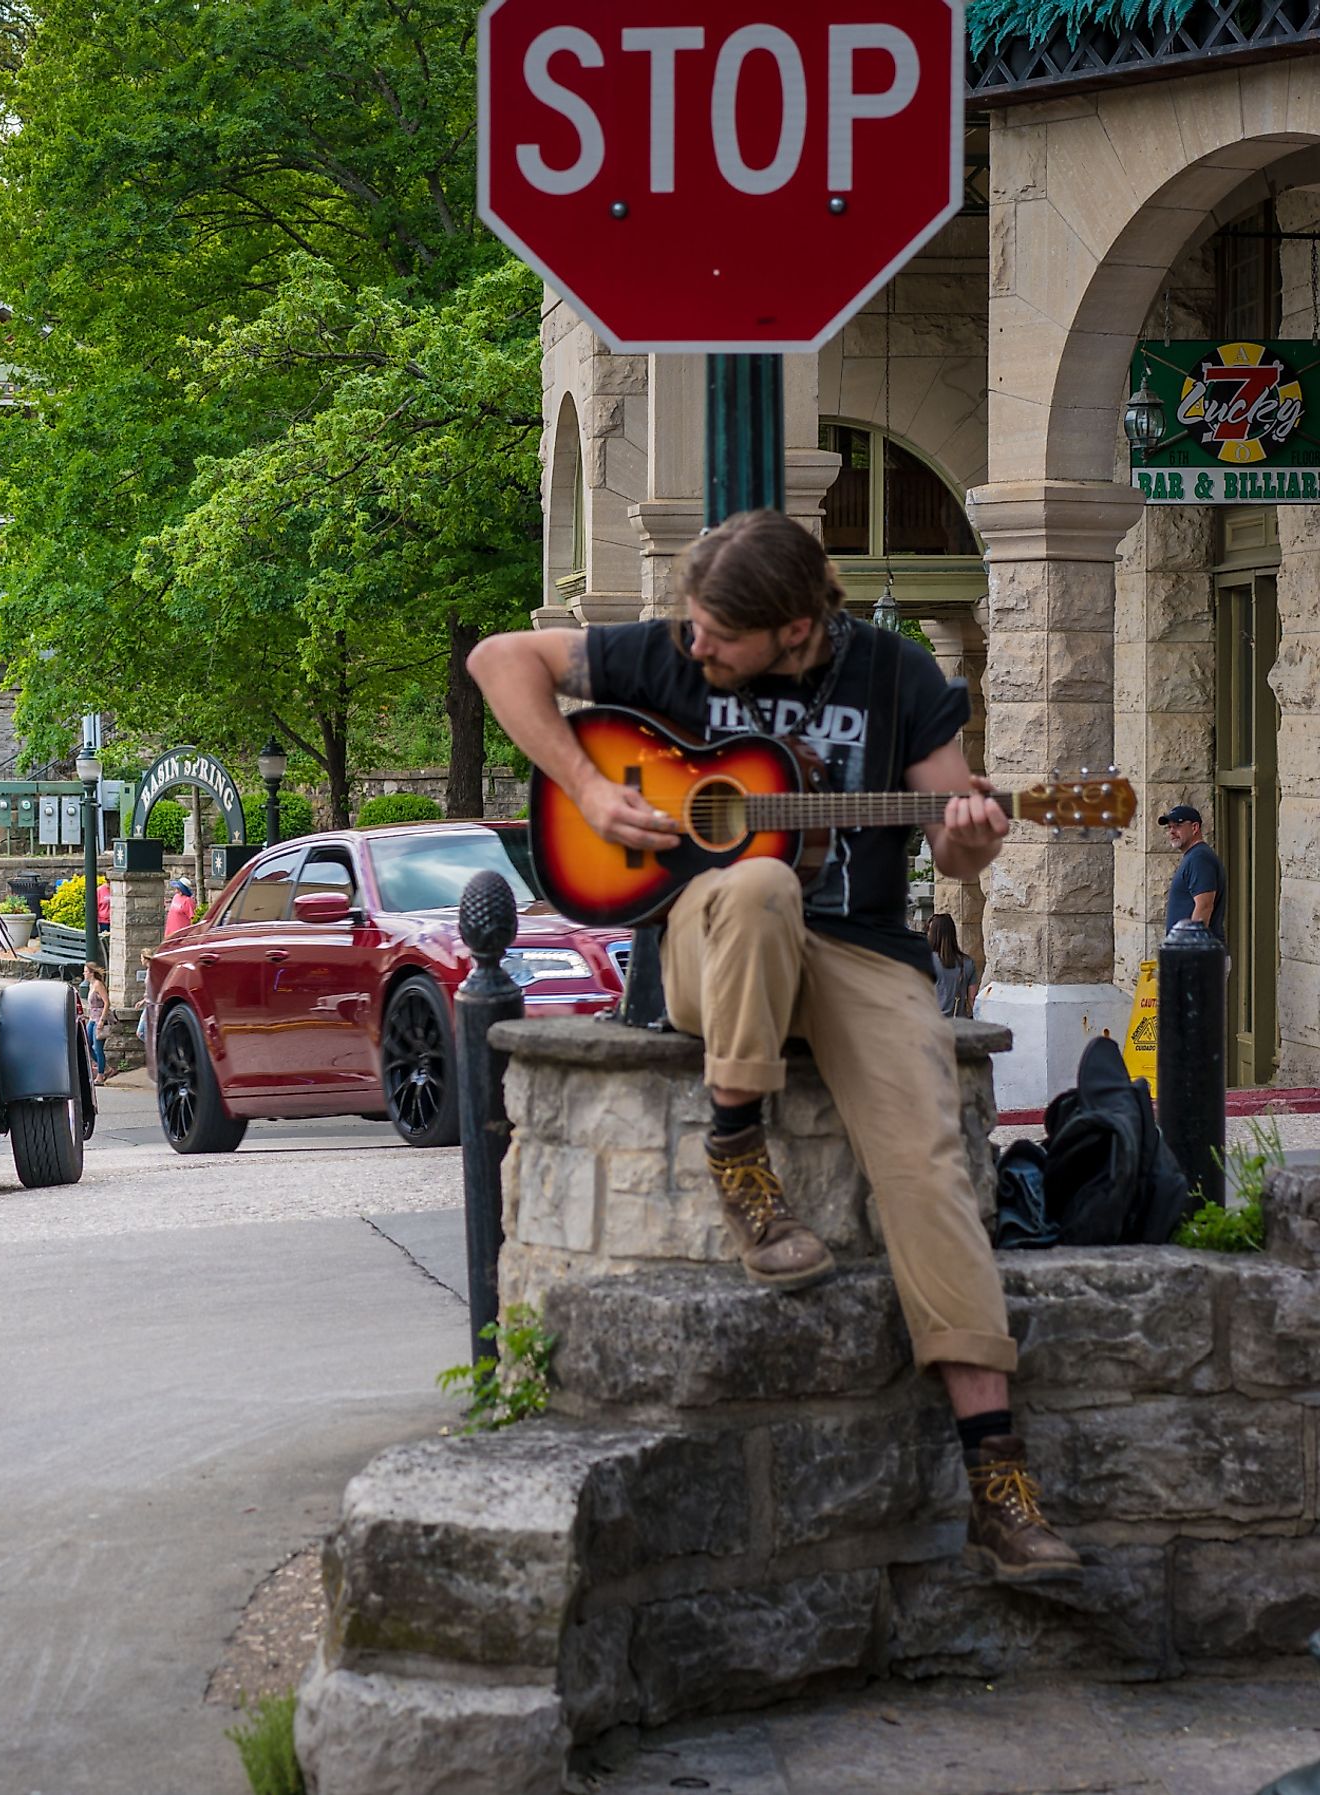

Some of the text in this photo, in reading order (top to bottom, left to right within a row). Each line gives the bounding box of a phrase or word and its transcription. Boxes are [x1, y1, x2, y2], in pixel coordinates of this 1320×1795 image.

[516, 22, 921, 195] STOP
[1177, 381, 1306, 437] Lucky
[1204, 366, 1280, 441] 7
[1138, 472, 1320, 499] BAR & BILLIAR
[141, 755, 235, 812] BASIN SPRING
